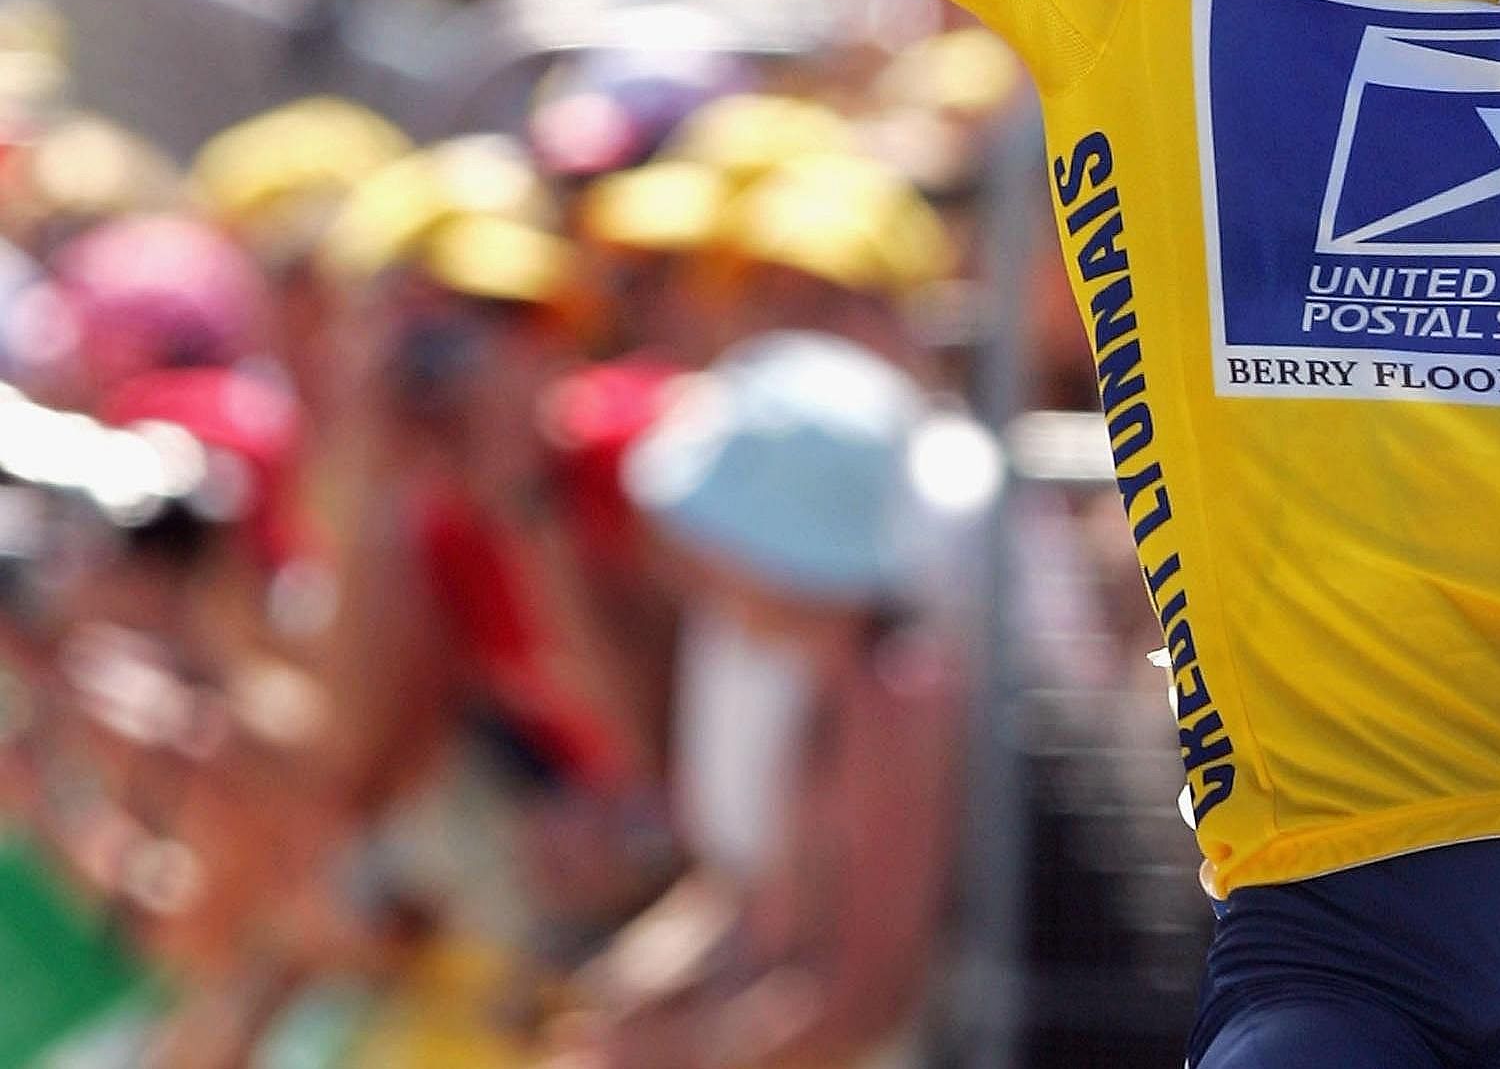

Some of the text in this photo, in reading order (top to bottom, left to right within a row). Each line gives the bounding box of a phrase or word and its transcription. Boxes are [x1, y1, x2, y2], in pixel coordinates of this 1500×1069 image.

[1306, 265, 1500, 300] UNITED
[1300, 302, 1484, 340] POSTAL
[1227, 357, 1358, 388] BERRY
[1053, 130, 1236, 829] CREDIT LYONNAIS
